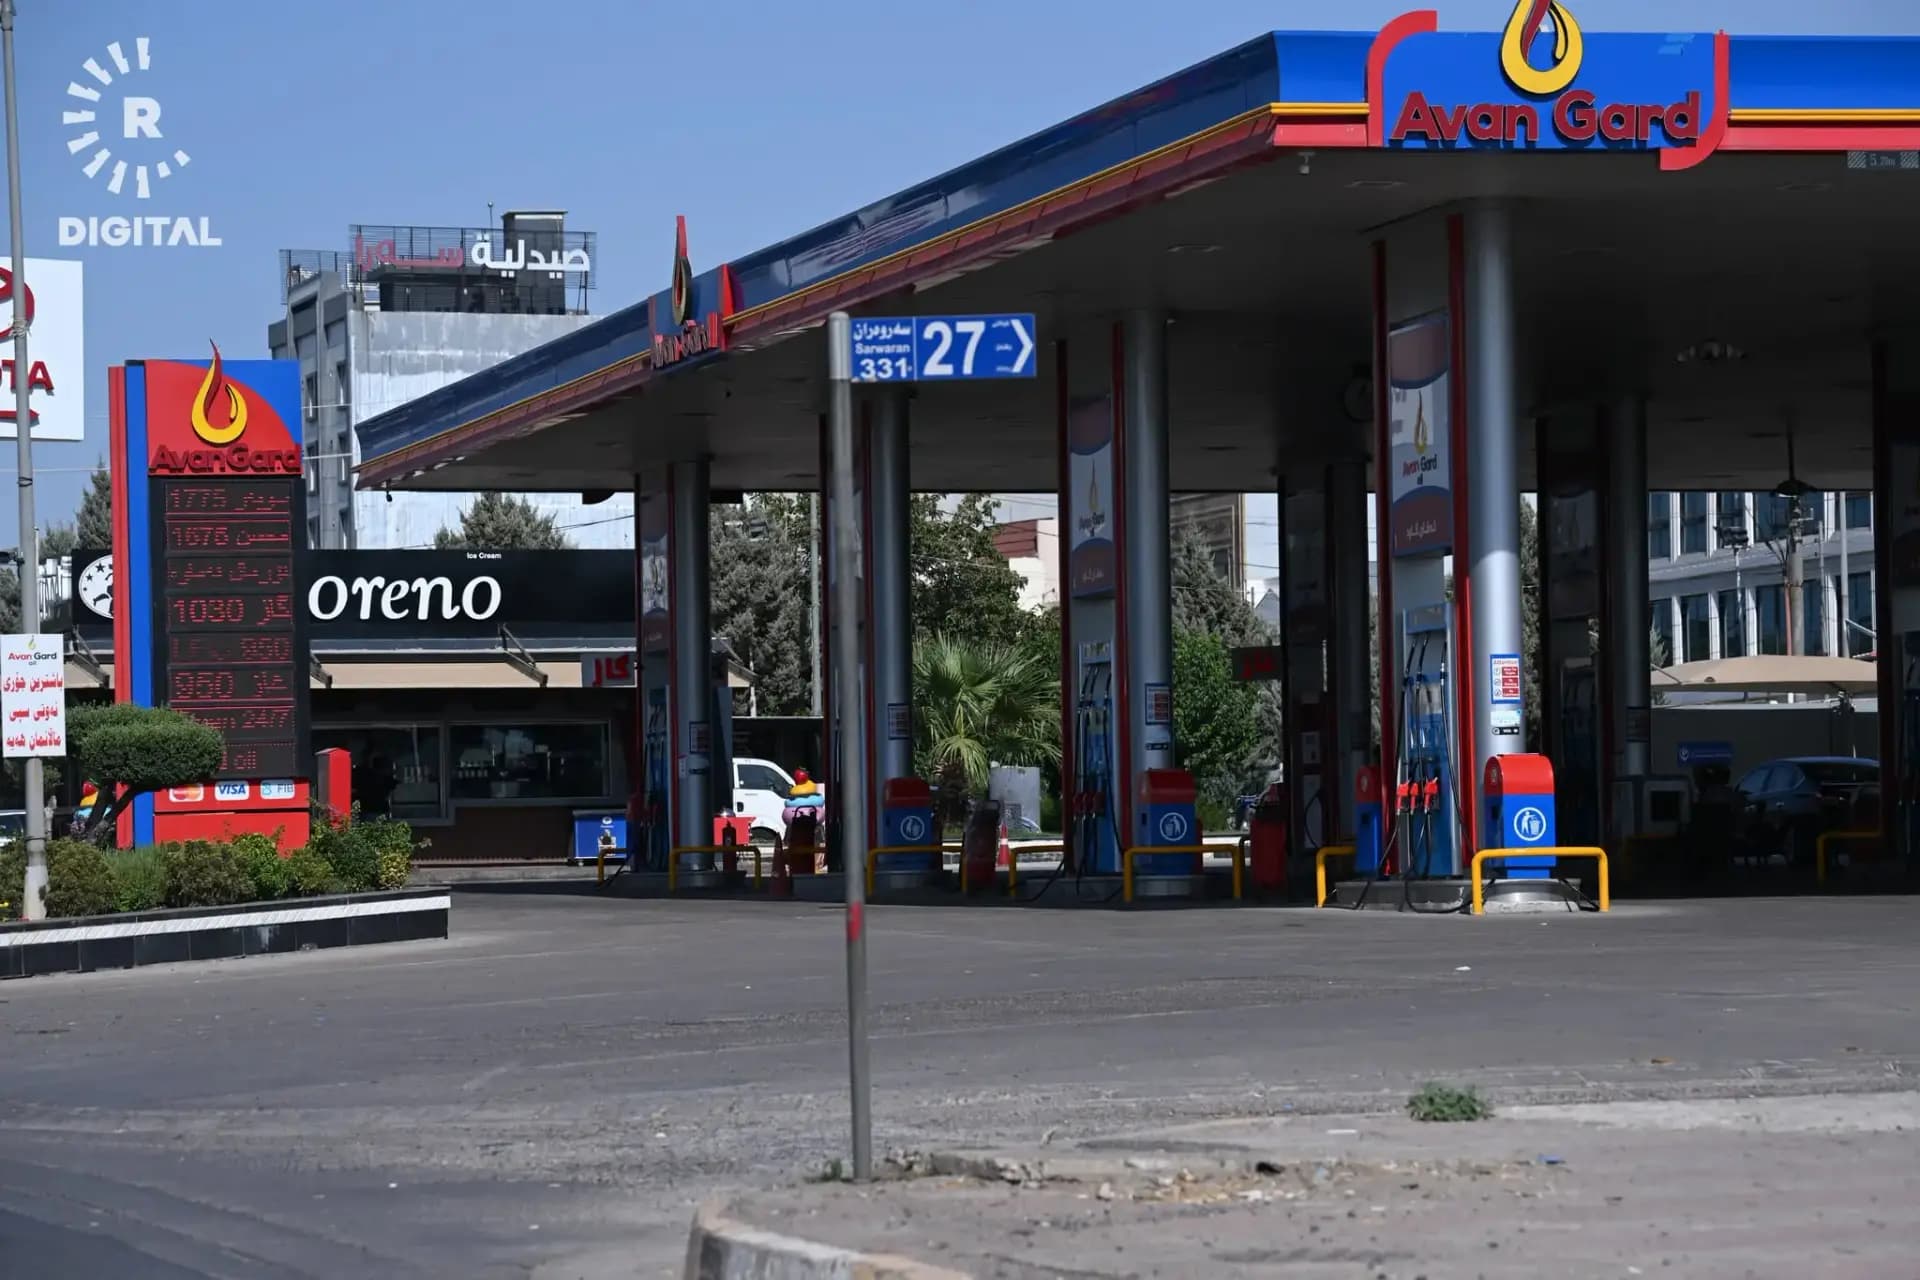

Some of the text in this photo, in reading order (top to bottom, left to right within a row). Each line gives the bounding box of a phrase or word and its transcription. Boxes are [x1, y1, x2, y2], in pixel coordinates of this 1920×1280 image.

[1392, 90, 1700, 141] Avan Gard
[471, 233, 590, 278] صيدلية
[855, 343, 910, 355] Sarwaran
[923, 321, 985, 375] 27
[860, 358, 908, 379] 331
[173, 599, 245, 623] 1030
[34, 652, 57, 660] Gard
[218, 784, 246, 795] VISA
